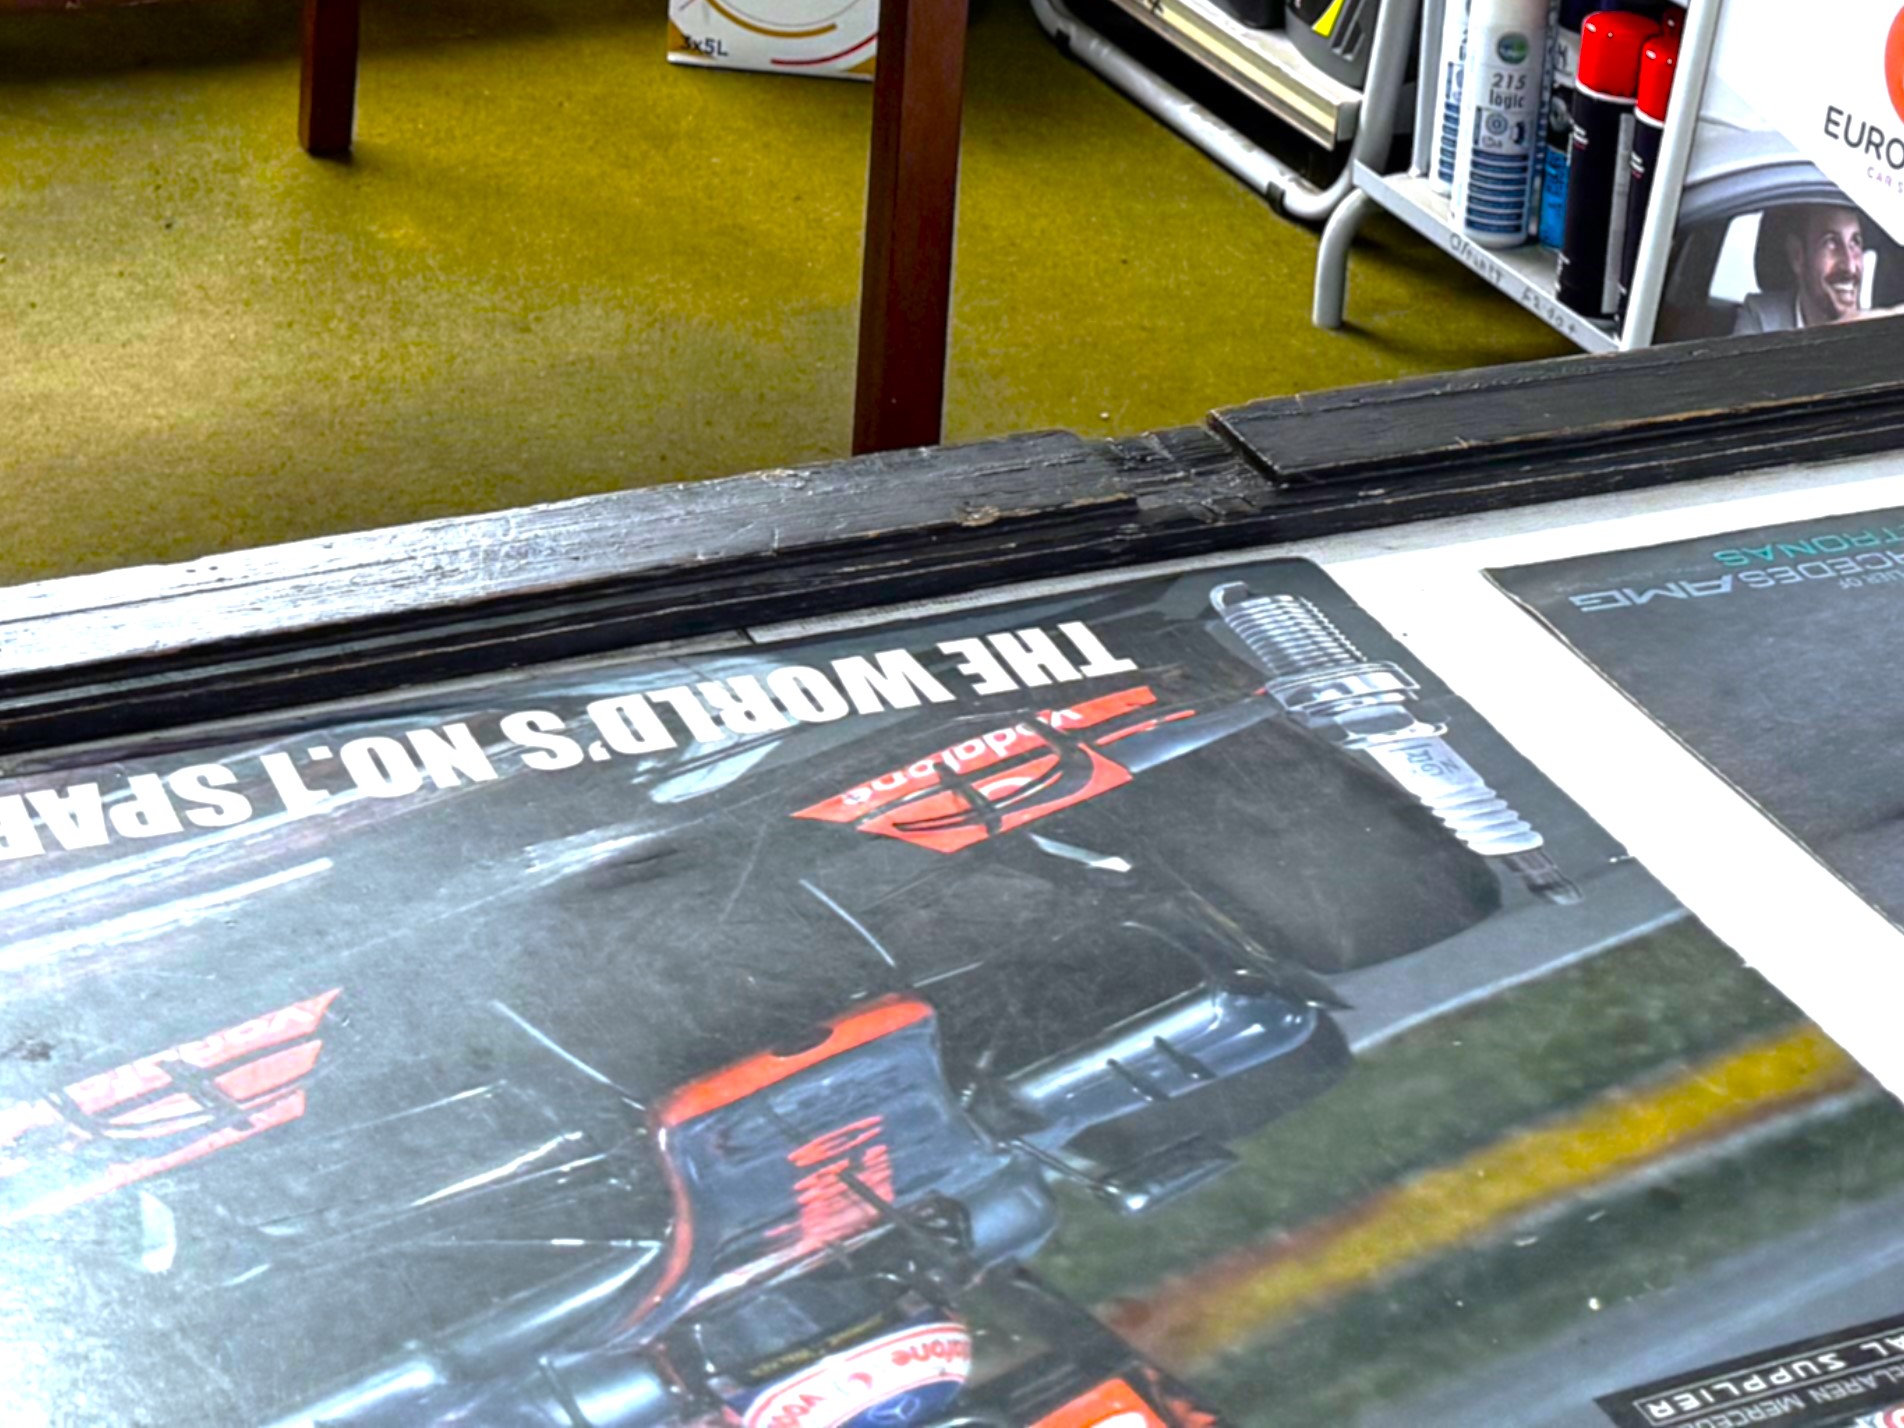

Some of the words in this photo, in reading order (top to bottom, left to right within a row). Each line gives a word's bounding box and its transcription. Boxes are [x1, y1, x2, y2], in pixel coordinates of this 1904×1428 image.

[1488, 89, 1526, 111] logic
[1491, 72, 1527, 90] 215
[1866, 163, 1898, 189] CAR
[949, 618, 1136, 697] THE
[525, 645, 937, 778] WORLD'S
[284, 714, 494, 824] NO.1
[1648, 1349, 1847, 1420] SUPPLIER
